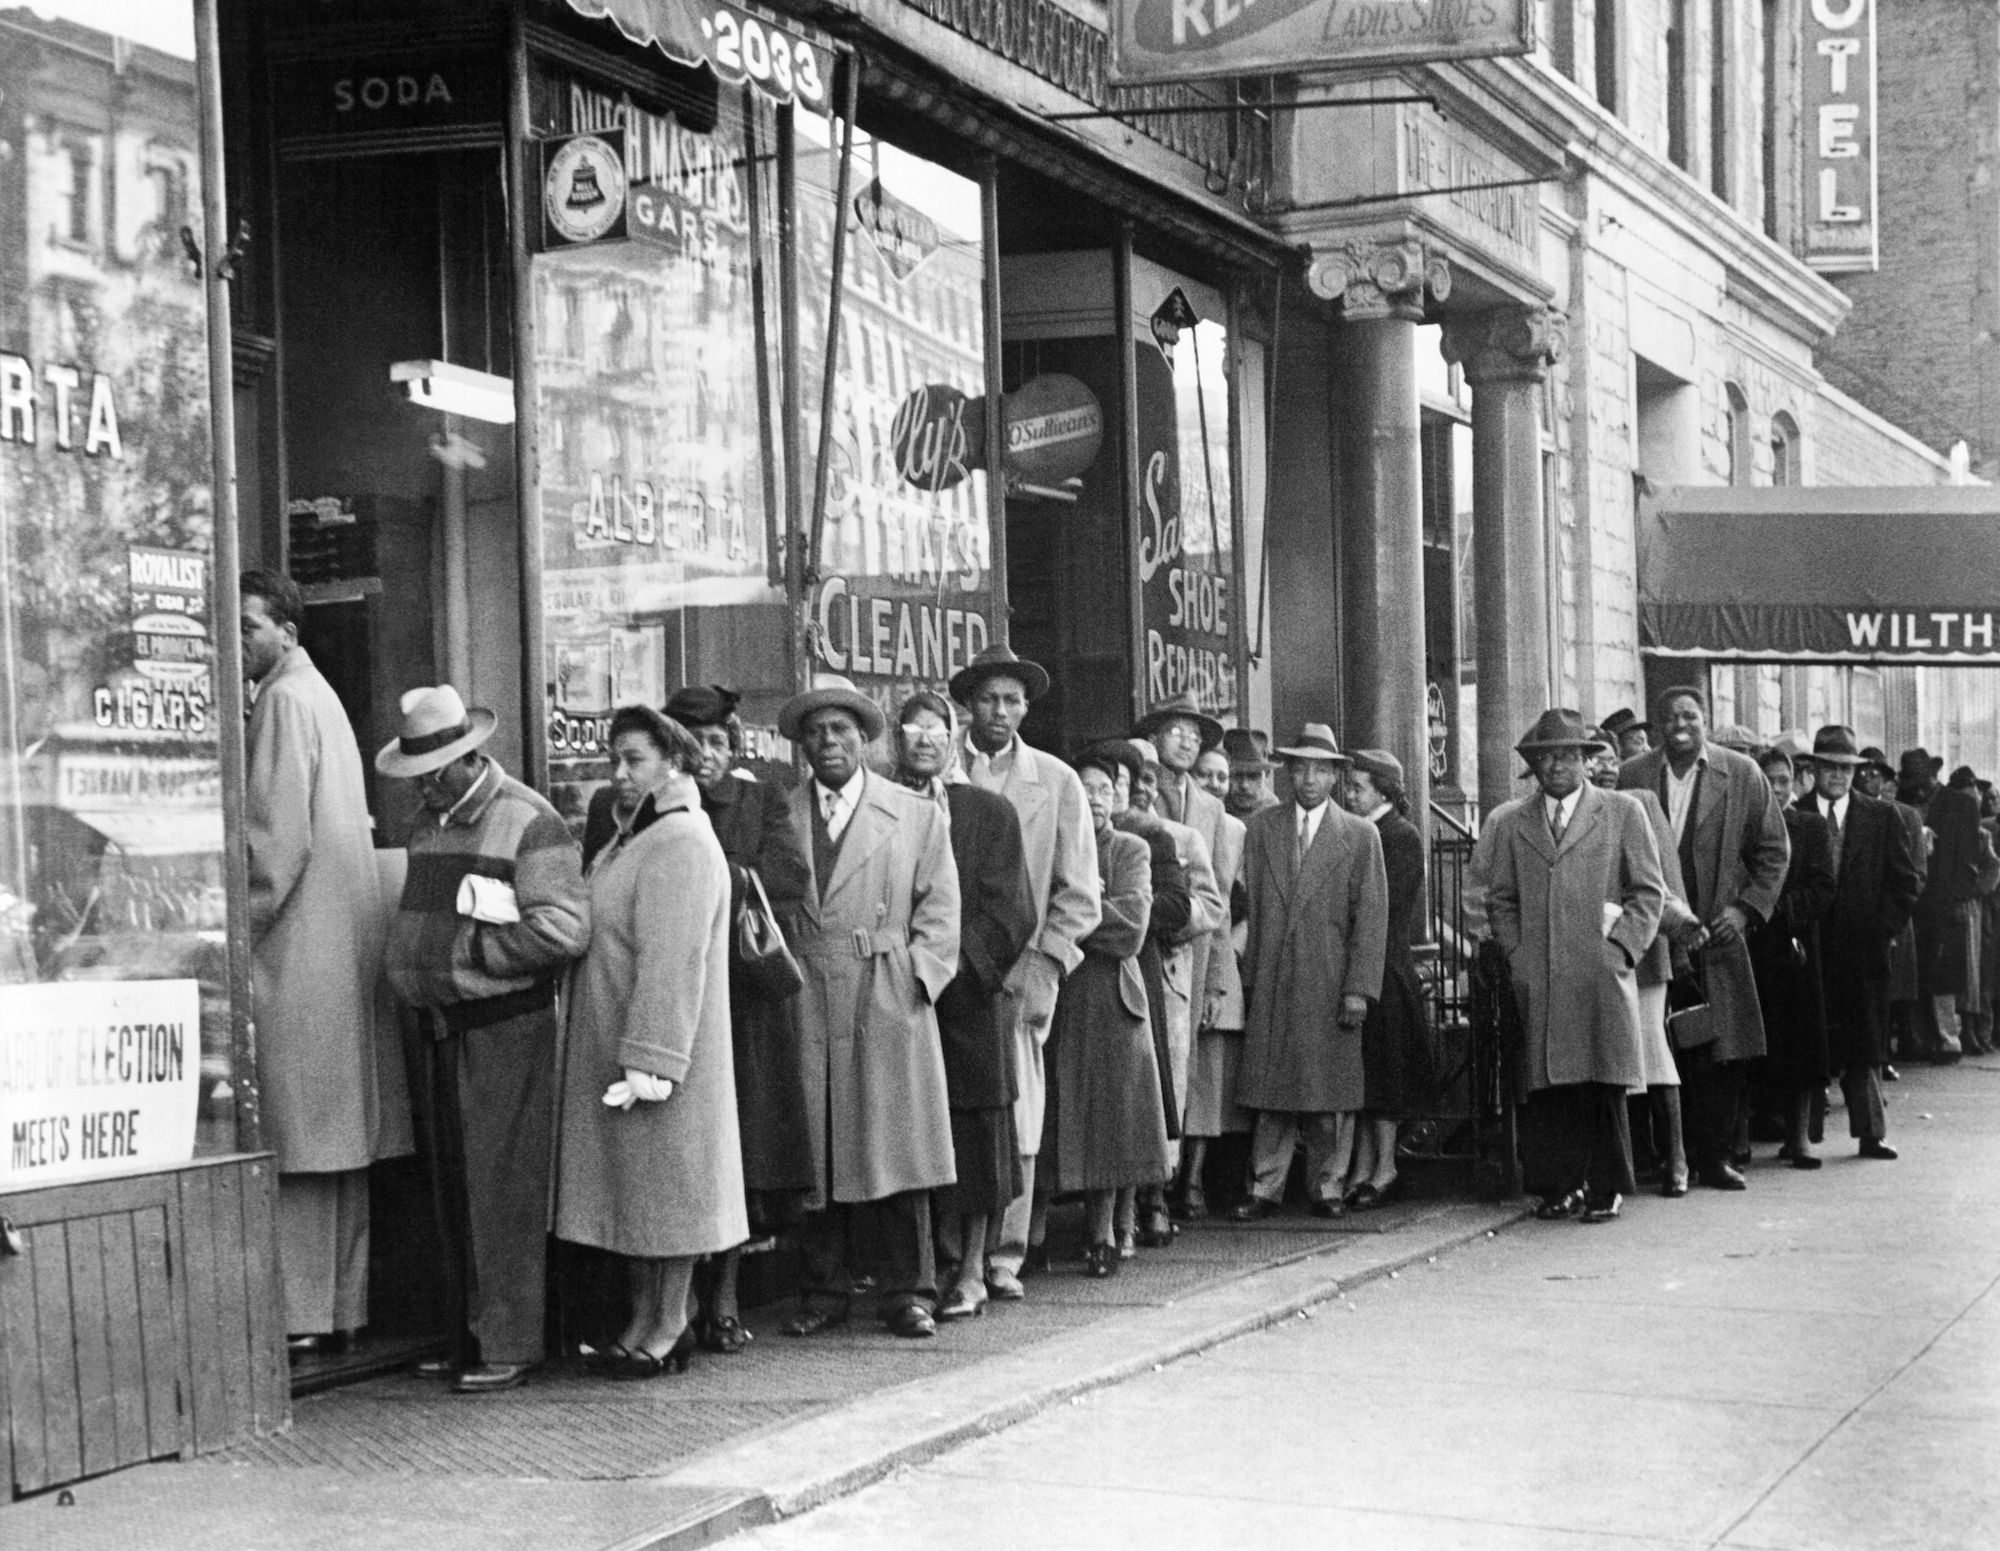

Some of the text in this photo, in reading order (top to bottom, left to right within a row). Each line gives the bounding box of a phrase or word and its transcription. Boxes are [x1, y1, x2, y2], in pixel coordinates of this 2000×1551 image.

[714, 9, 823, 100] 2033
[335, 73, 451, 110] SODA
[0, 352, 123, 459] RTA
[587, 470, 749, 563] ALBERTA
[130, 551, 204, 590] ROYALIST
[1168, 568, 1228, 636] SHOE
[819, 576, 987, 679] CLEANED
[1847, 613, 1993, 648] WILTH
[94, 688, 205, 732] CIGARS
[76, 1022, 184, 1087] ELECTION
[11, 1109, 141, 1170] MEETS HERE
